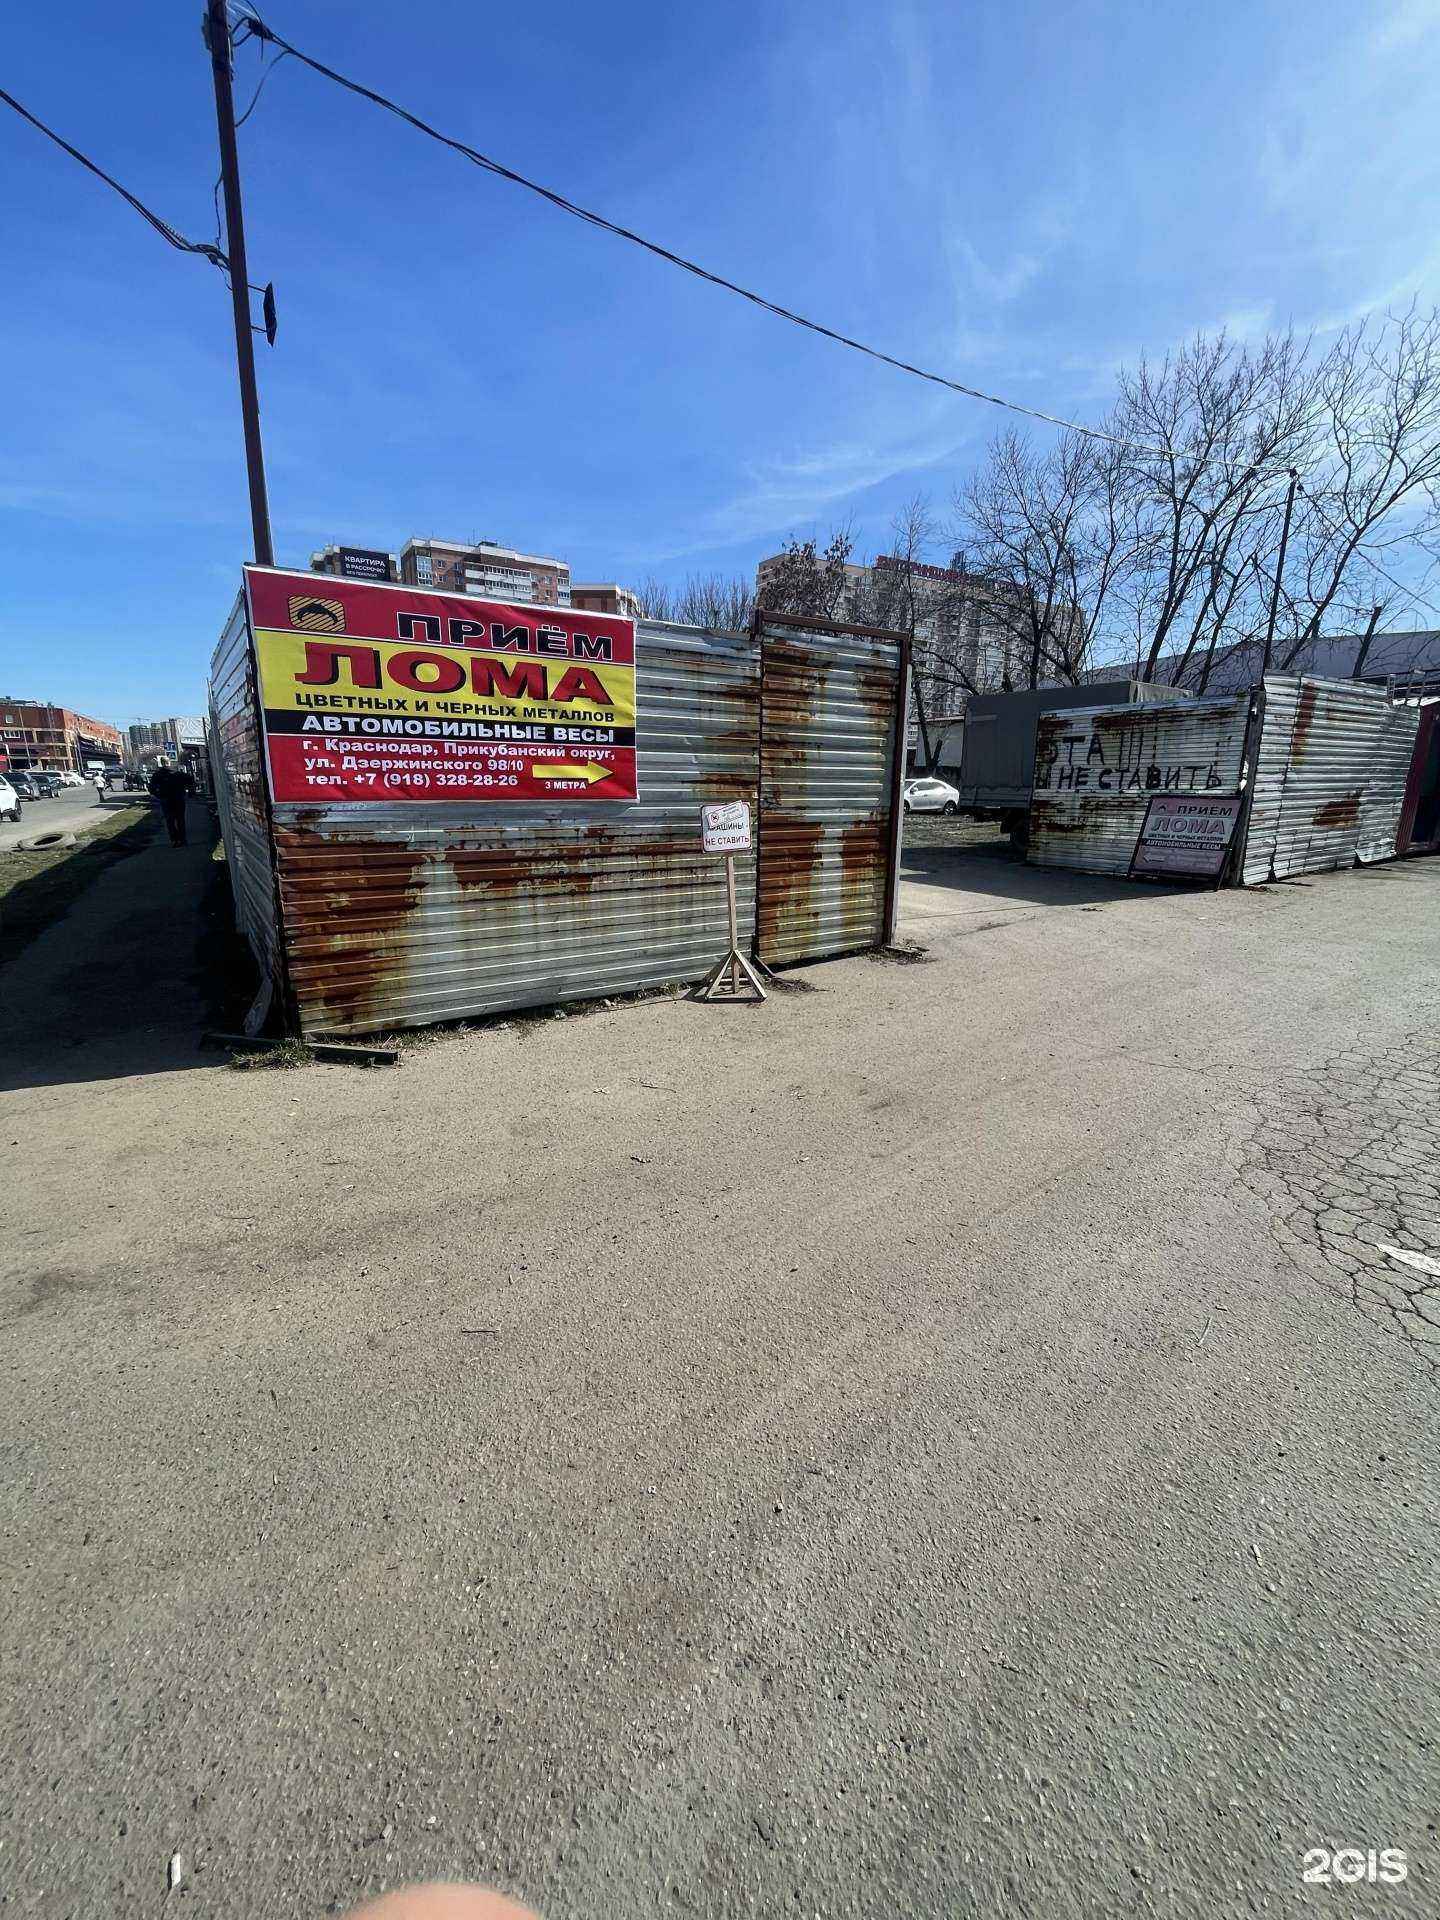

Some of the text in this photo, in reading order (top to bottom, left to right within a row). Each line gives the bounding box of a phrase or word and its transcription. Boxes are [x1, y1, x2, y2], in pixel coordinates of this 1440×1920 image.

[344, 555, 386, 567] КВАРТИРА
[396, 611, 613, 660] ПРИЁМ
[294, 641, 616, 705] ЛОМА
[295, 692, 615, 723] ЦВЕТНЫХ И ЧЕРНЫХ МЕТАЛЛОВ
[301, 715, 614, 743] АВТОМОБИЛЬНЫЕ ВЕСЫ
[302, 738, 615, 760] г. Краснодар, Прикубанский округ,
[304, 756, 524, 771] ул. Дзержинского 98/10
[305, 773, 519, 788] тел. +7 (918) 328-28-26
[1058, 765, 1092, 789] НЕ
[1098, 763, 1222, 789] СТАВИТЬ
[545, 781, 587, 790] 3 МЕТРА
[709, 822, 744, 831] АШИНЫ
[1150, 817, 1226, 835] ЛОМА
[705, 836, 750, 846] НЕ СТАВИТЬ
